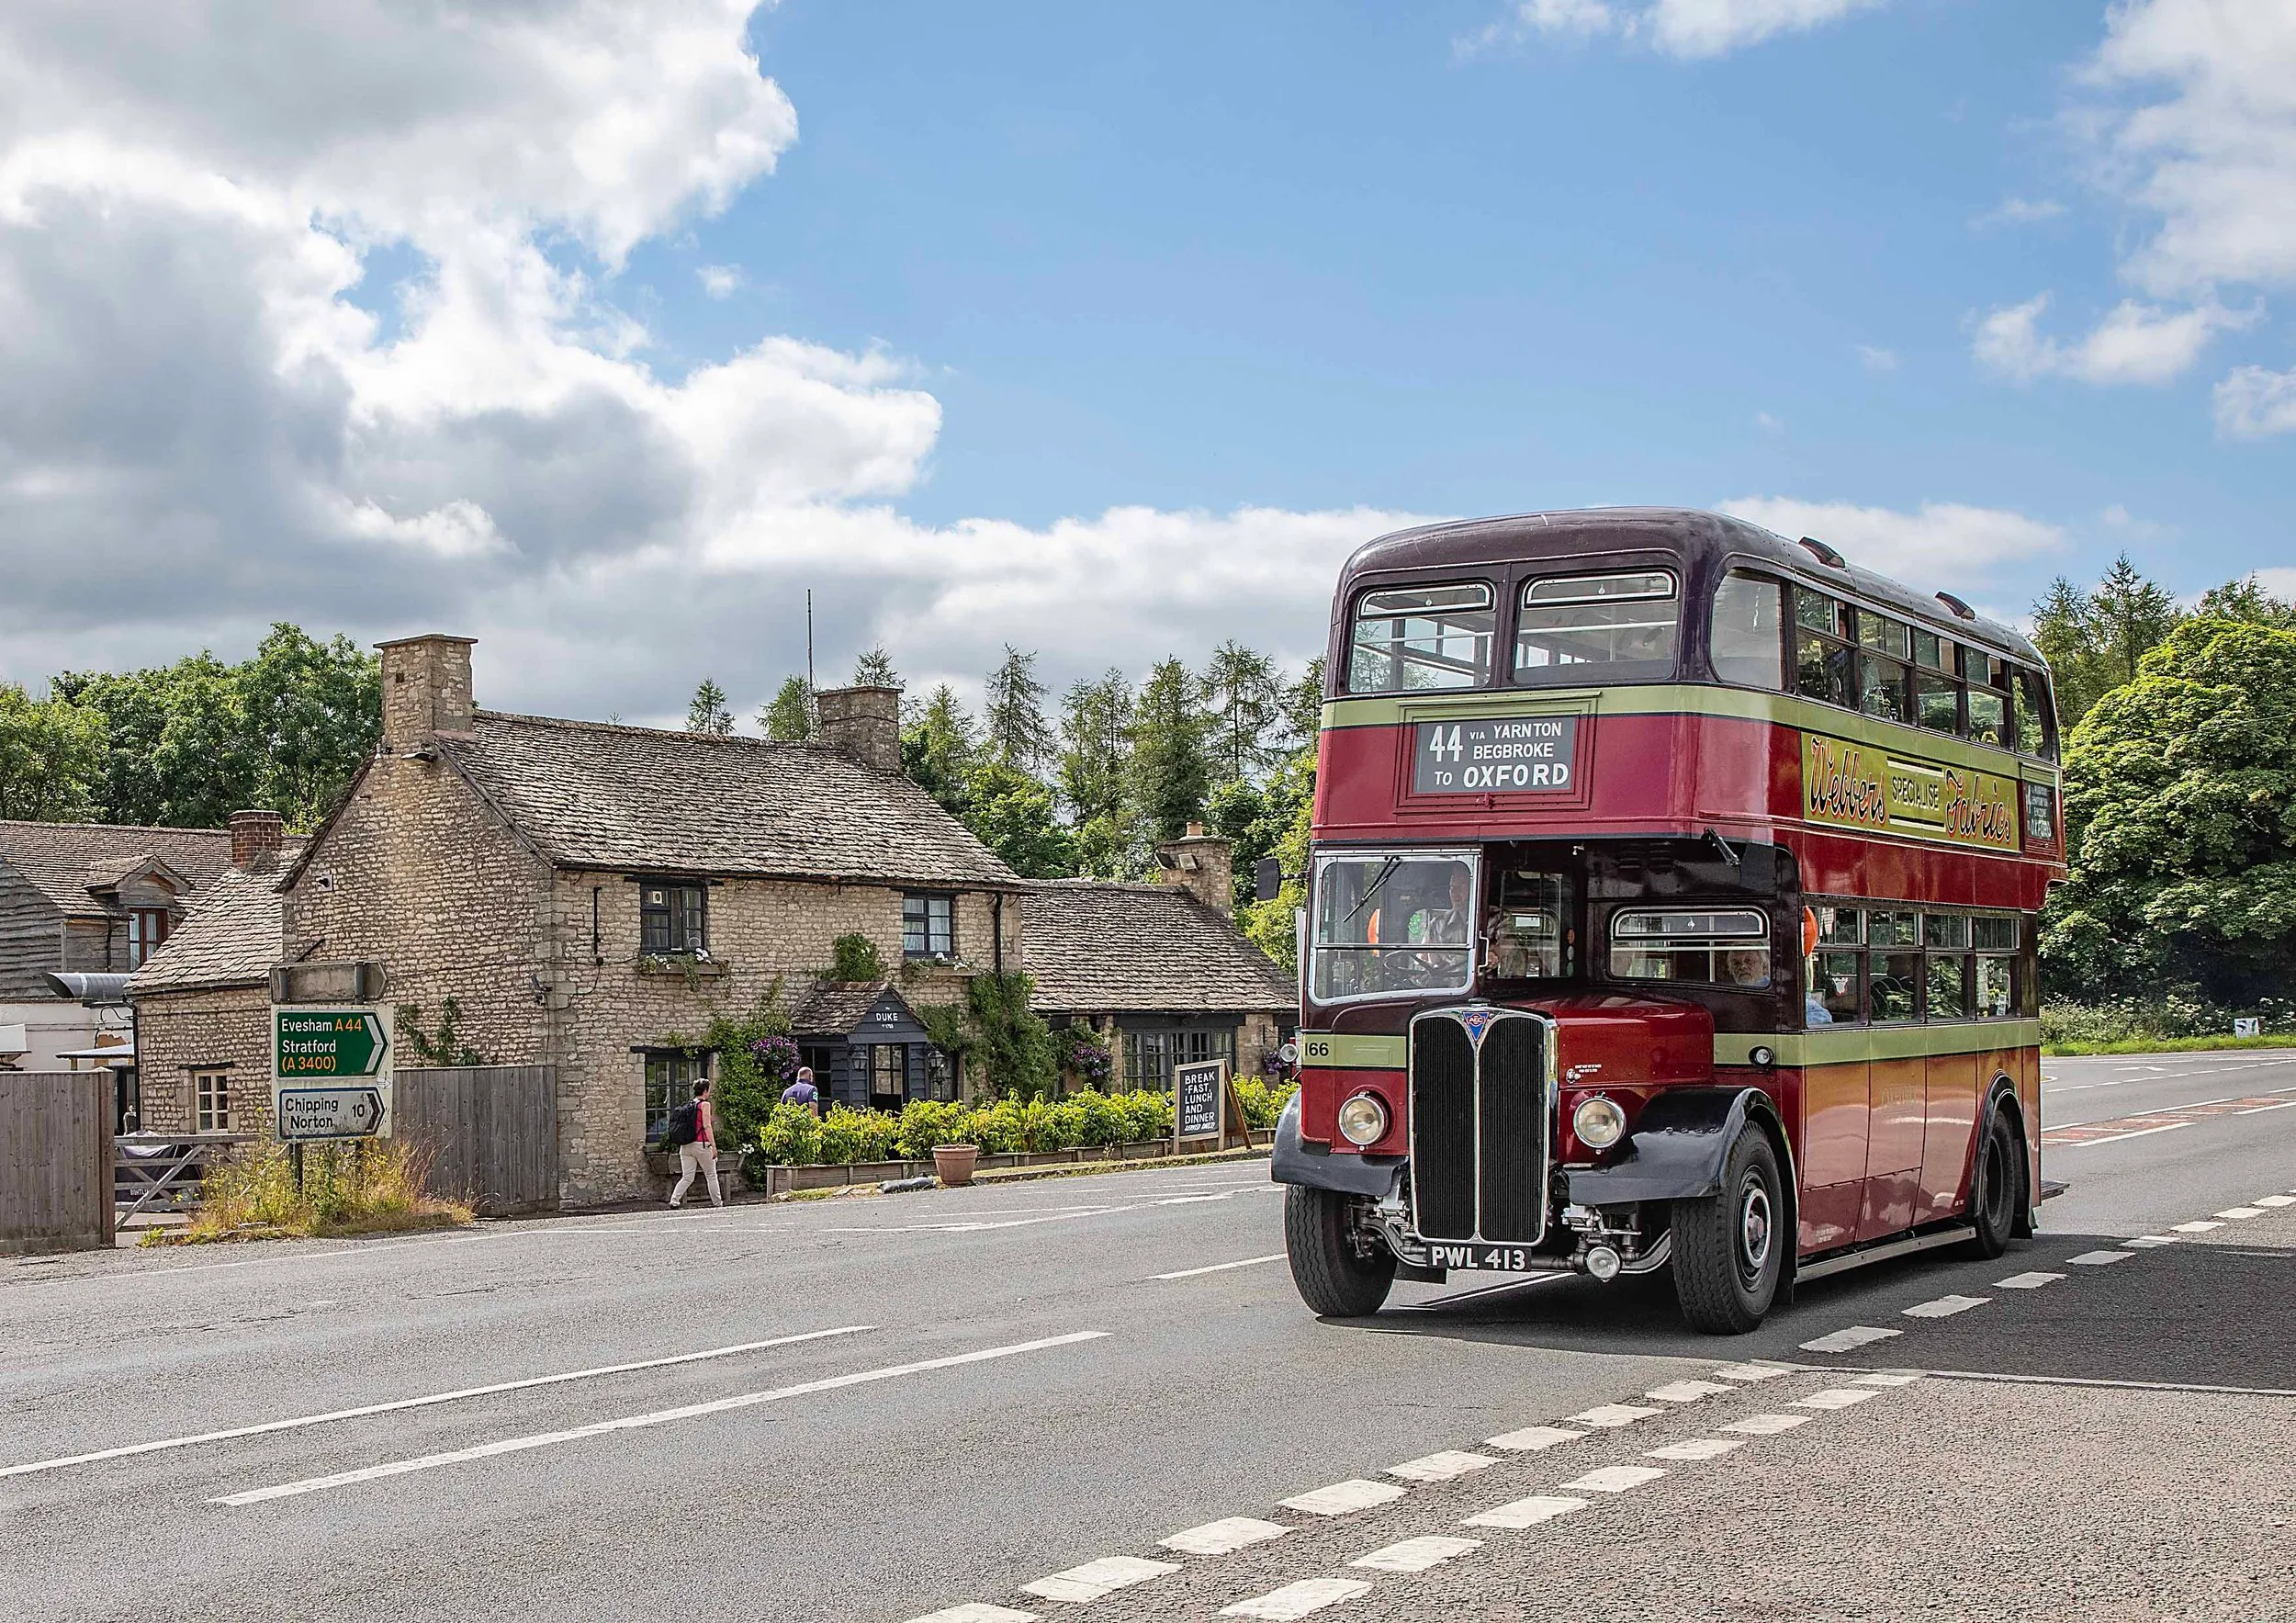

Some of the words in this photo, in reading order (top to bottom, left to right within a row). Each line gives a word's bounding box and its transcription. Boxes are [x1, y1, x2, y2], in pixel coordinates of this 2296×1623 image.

[1429, 725, 1464, 762] 44
[1469, 731, 1486, 740] VIA
[1493, 722, 1562, 739] YARNTON
[1473, 742, 1554, 761] BEGBROKE
[1434, 771, 1453, 786] TO
[1463, 762, 1570, 788] OXFORD
[1809, 736, 1886, 825] Webbers
[1891, 775, 1940, 811] SPECIALISE
[1944, 767, 2012, 845] Fabrics
[875, 1012, 898, 1021] DUKE
[281, 1018, 332, 1032] Evesham
[282, 1039, 336, 1054] Stratford
[1304, 1042, 1330, 1056] 166
[1184, 1071, 1215, 1085] BREAK
[1184, 1092, 1212, 1105] LUNCH
[285, 1098, 339, 1114] Chipping
[351, 1104, 366, 1118] 10
[1185, 1104, 1203, 1115] AND
[290, 1115, 333, 1129] Norton
[1184, 1111, 1215, 1125] DINNER
[1431, 1245, 1479, 1268] PWL
[1484, 1248, 1525, 1270] 413
